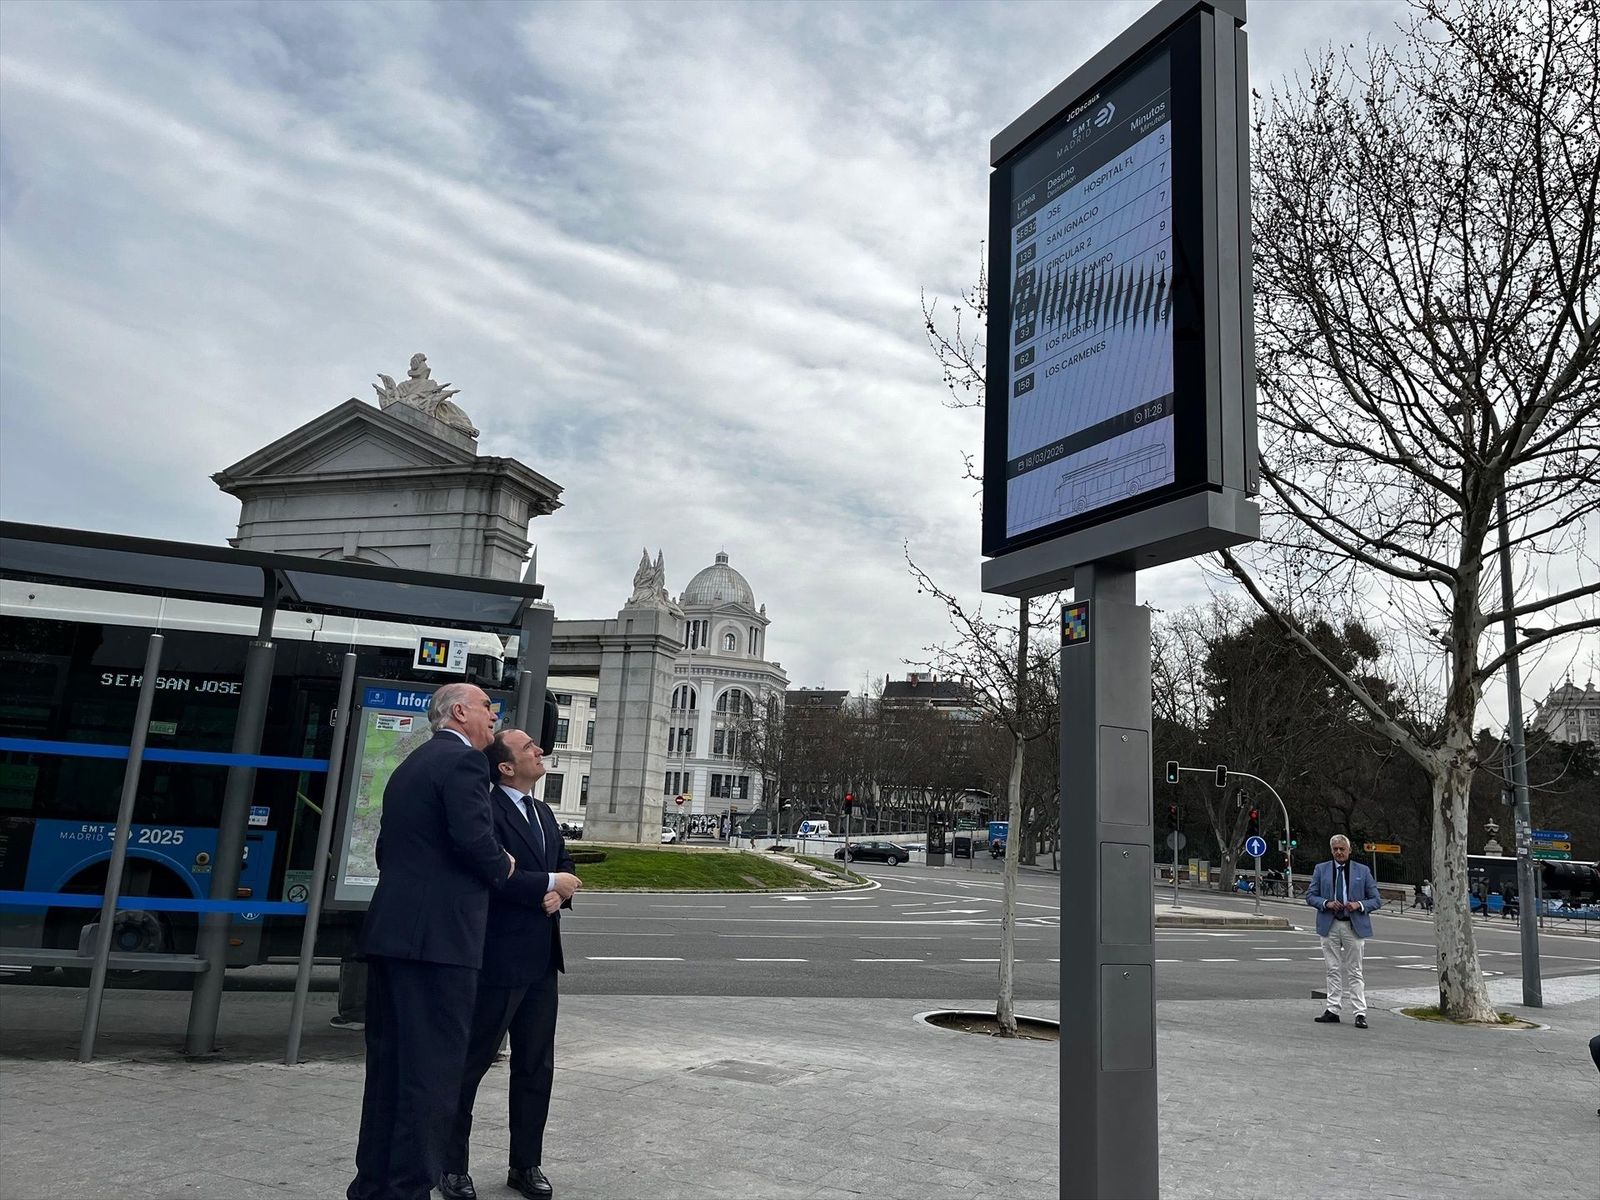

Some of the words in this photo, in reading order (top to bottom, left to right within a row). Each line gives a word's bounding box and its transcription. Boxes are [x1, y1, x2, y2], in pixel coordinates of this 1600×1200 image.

[1066, 92, 1101, 122] JCDecaux
[1072, 117, 1091, 138] EMT
[1047, 165, 1075, 190] Destino
[1130, 101, 1165, 131] Minutos
[1056, 129, 1092, 158] MADRID
[1083, 163, 1123, 196] HOSPITAL
[1159, 134, 1165, 145] 3
[1020, 248, 1032, 263] 138
[1046, 228, 1063, 246] SAN
[1063, 206, 1099, 235] IGNACIO
[1159, 161, 1166, 174] 7
[1159, 220, 1166, 231] 9
[1046, 241, 1085, 271] CIRCULAR
[1086, 236, 1092, 248] 2
[1159, 190, 1166, 202] 7
[1020, 326, 1030, 339] 39
[1156, 249, 1166, 262] 10
[1020, 353, 1030, 365] 62
[1045, 336, 1060, 352] LOS
[1018, 378, 1031, 392] 158
[1045, 363, 1060, 379] LOS
[1061, 340, 1106, 370] CARMENES
[1144, 403, 1163, 419] 11:28
[1025, 443, 1064, 468] 18/03/2026
[155, 677, 190, 691] SAN
[194, 680, 242, 695] JOSE
[59, 832, 104, 842] MADRID
[81, 825, 105, 833] EMT
[138, 828, 184, 845] 2025
